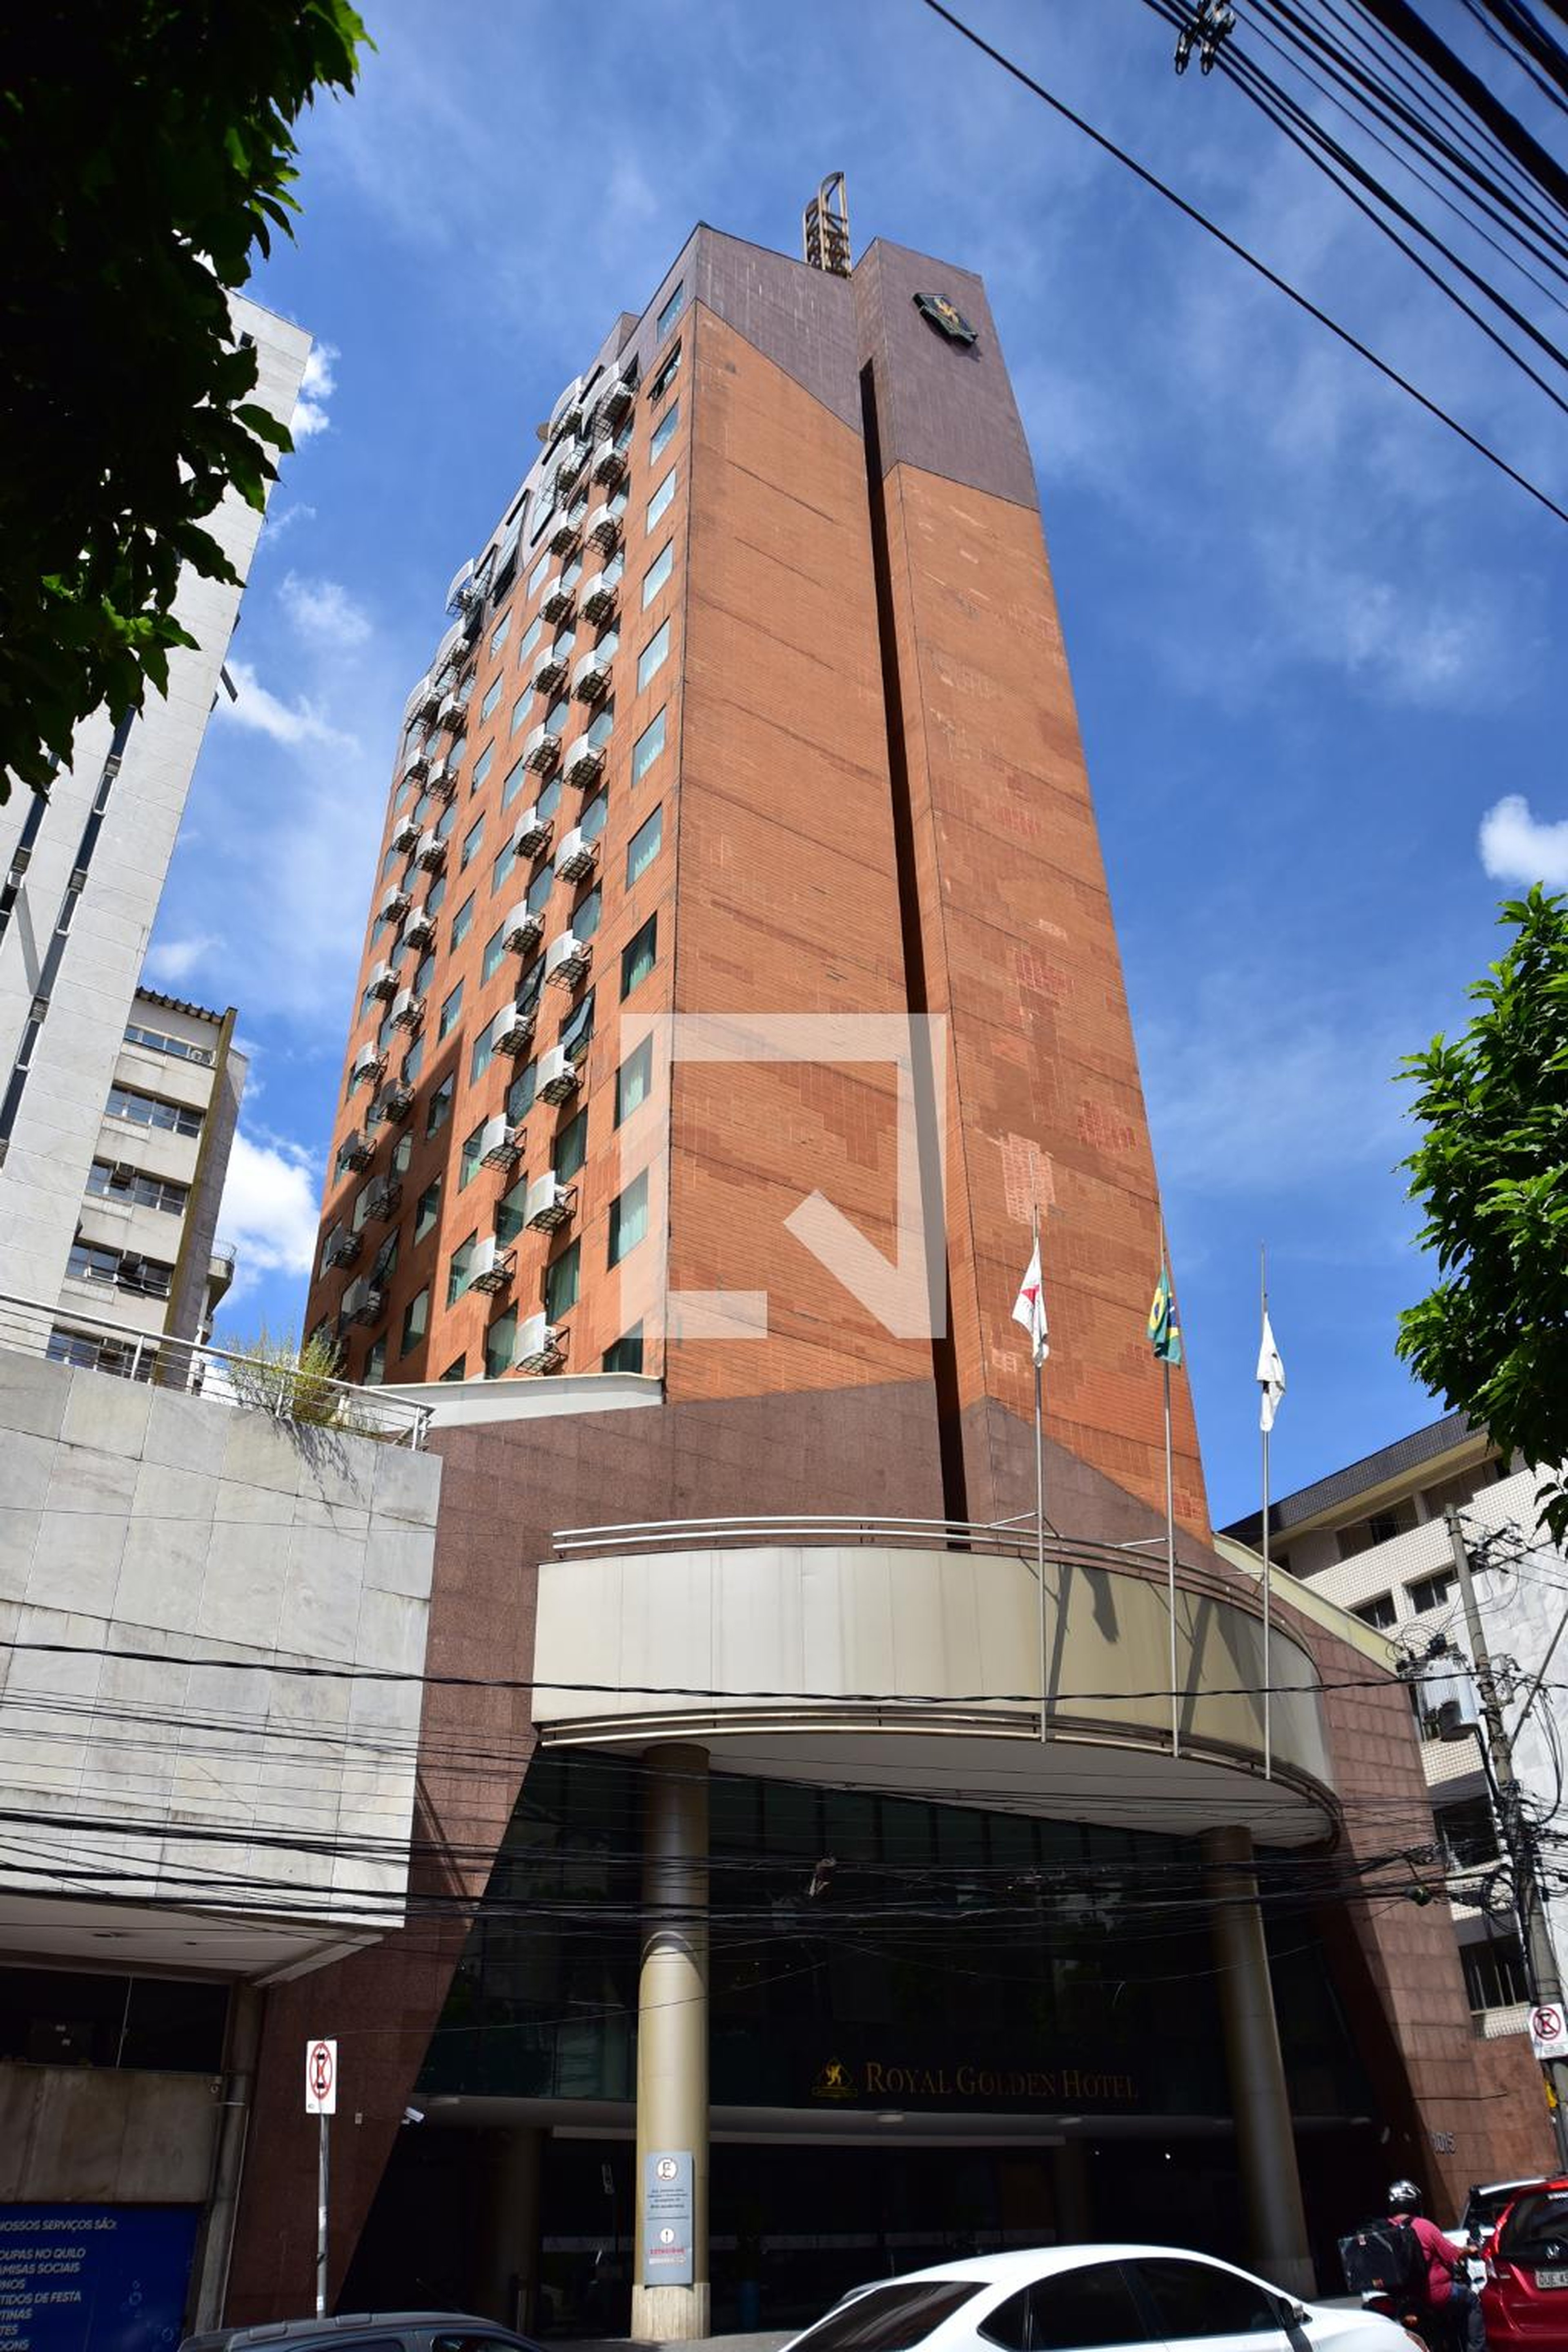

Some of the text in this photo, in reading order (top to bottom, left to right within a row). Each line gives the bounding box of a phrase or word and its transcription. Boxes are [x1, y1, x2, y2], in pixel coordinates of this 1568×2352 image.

[866, 2062, 1138, 2098] ROYAL GOLDEN HOTEL
[35, 2248, 51, 2259] NO
[53, 2247, 86, 2259] QUILO
[37, 2262, 81, 2274] SOCIAIS
[34, 2292, 49, 2303] DE
[50, 2291, 81, 2303] FESTA
